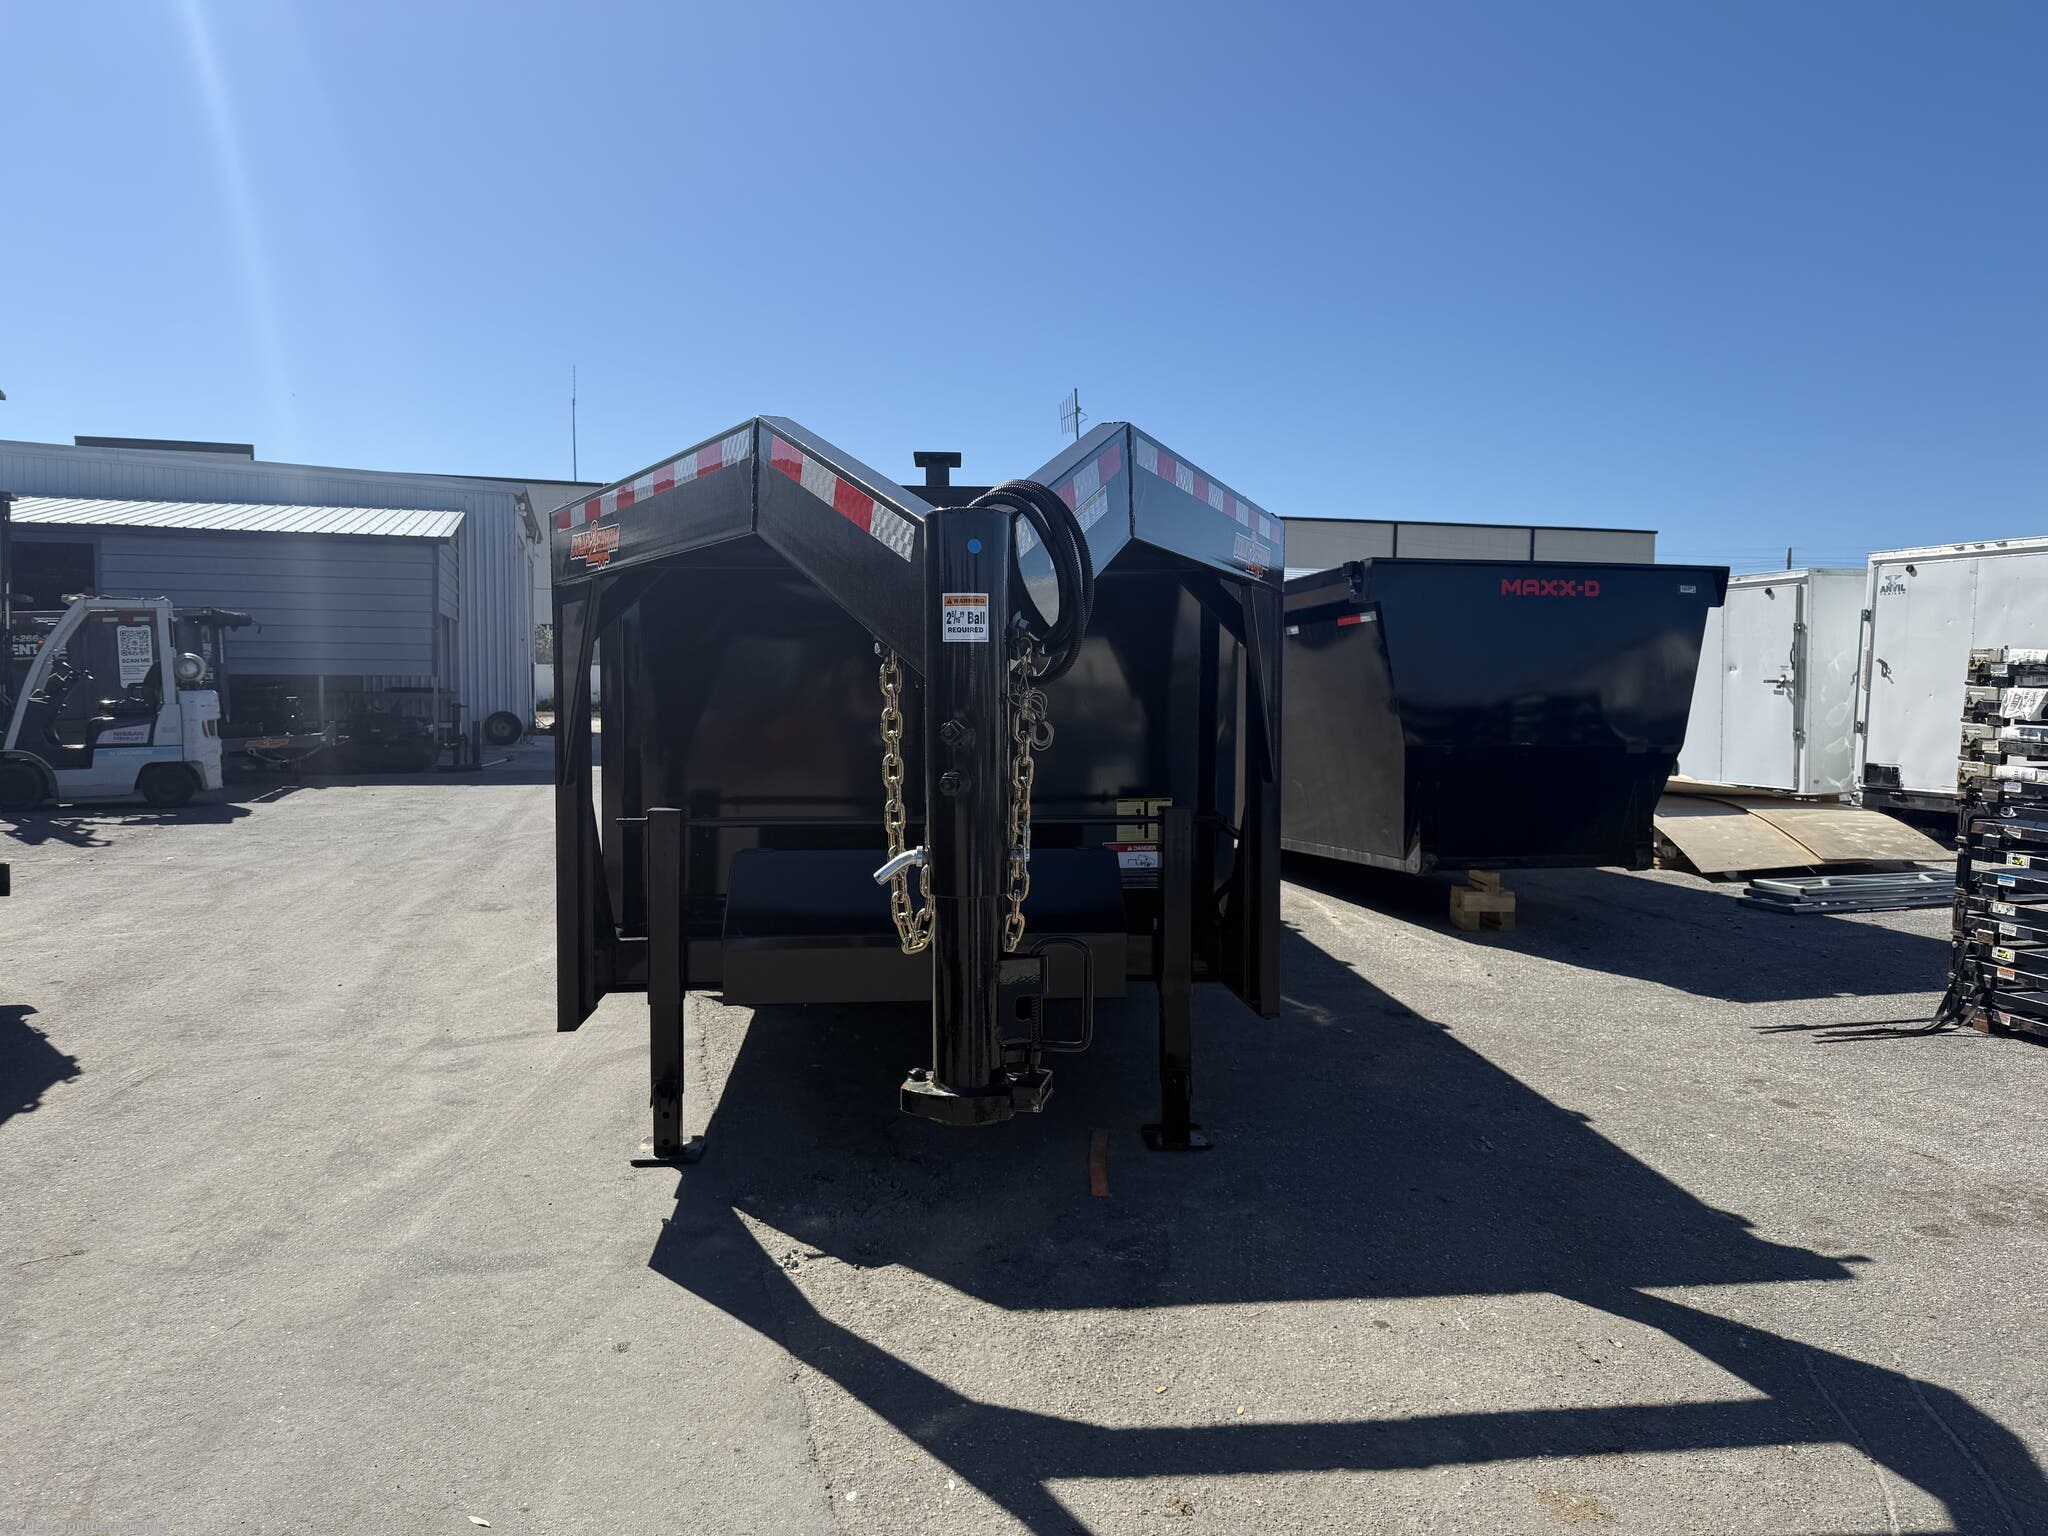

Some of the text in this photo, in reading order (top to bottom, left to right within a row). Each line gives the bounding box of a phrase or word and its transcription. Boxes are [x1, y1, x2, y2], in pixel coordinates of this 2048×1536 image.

[1501, 579, 1600, 597] MAXX-D
[1880, 584, 1906, 593] ANVIL
[967, 611, 985, 625] Ball
